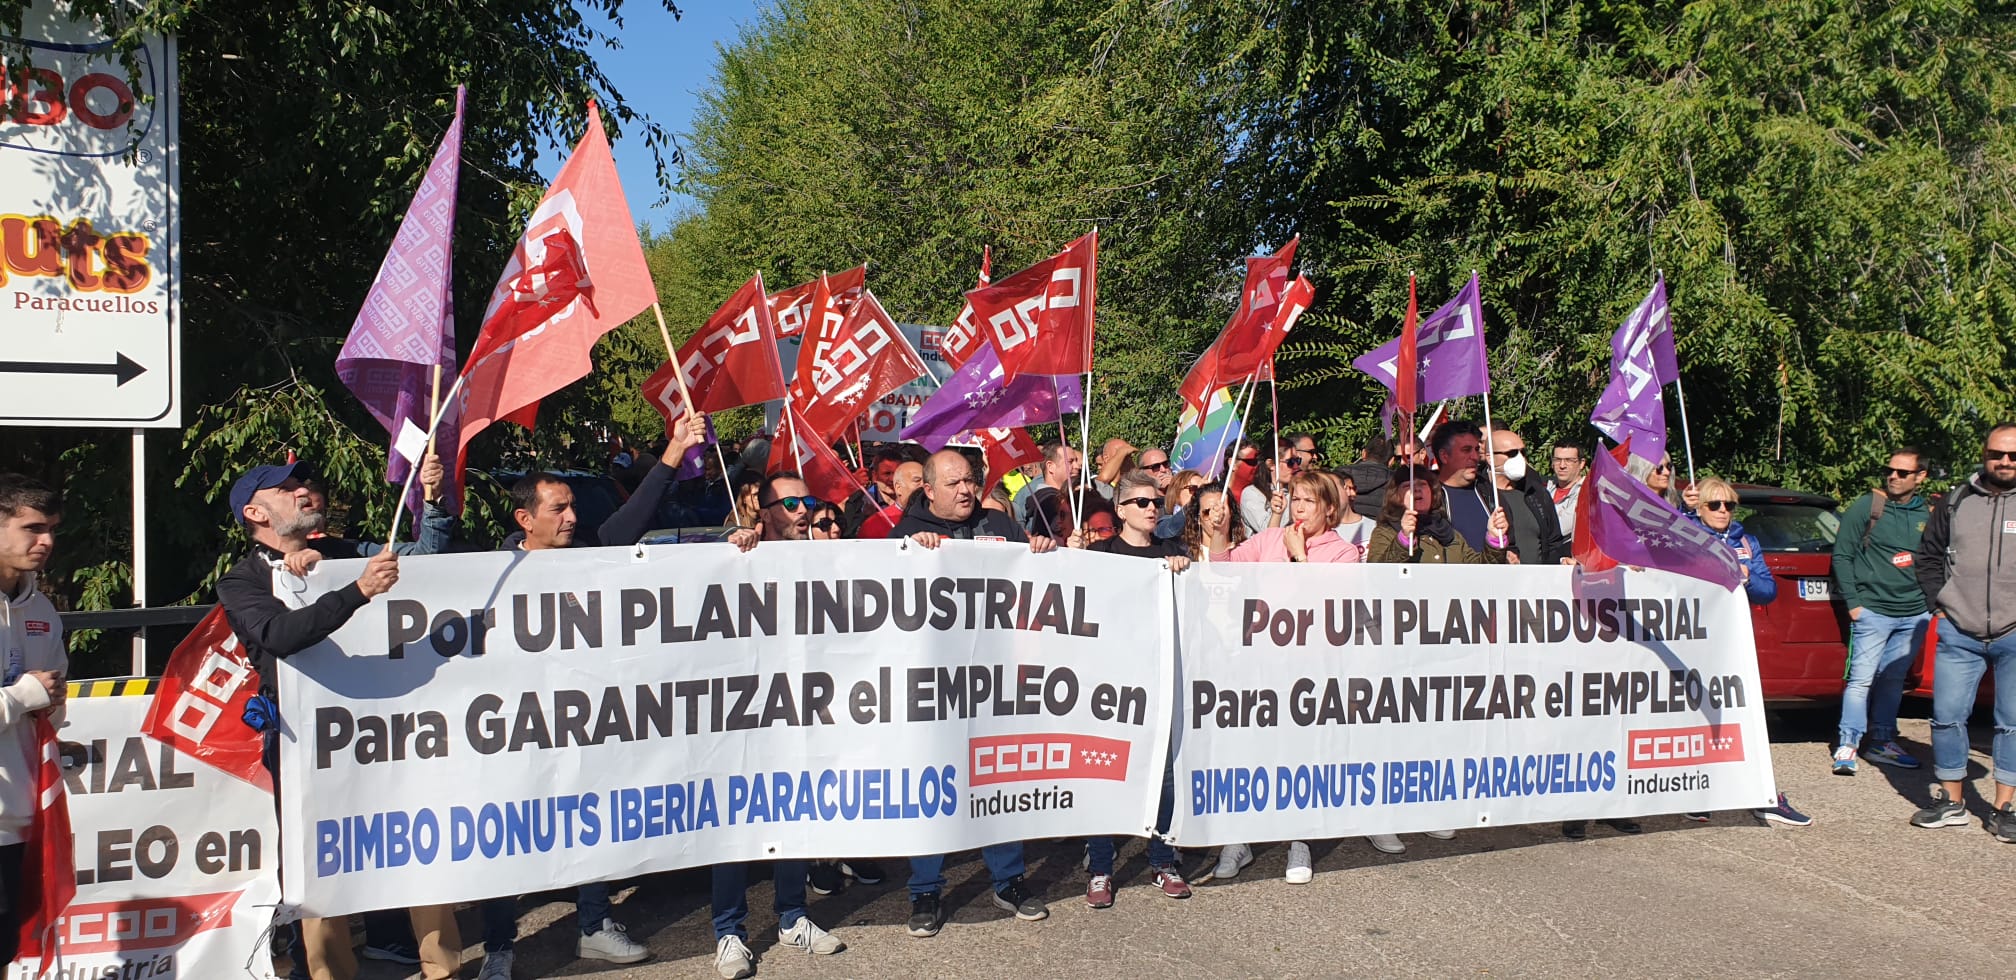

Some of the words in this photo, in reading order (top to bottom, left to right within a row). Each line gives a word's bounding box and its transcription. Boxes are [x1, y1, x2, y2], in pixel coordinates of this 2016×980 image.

[0, 63, 134, 129] BO
[0, 215, 150, 293] uts
[14, 291, 158, 314] Paracuellos
[388, 599, 495, 659] Por
[513, 590, 602, 653] UN
[621, 582, 777, 647] PLAN
[795, 577, 1099, 638] INDUSTRIAL
[1242, 598, 1314, 647] Por
[1324, 598, 1382, 647] UN
[1393, 598, 1498, 646] PLAN
[1508, 598, 1707, 644] INDUSTRIAL
[315, 706, 449, 769] Para
[465, 671, 835, 755] GARANTIZAR
[849, 666, 892, 724] el
[906, 664, 1079, 723] EMPLEO
[1090, 681, 1146, 727] en
[1192, 680, 1278, 729] Para
[1289, 674, 1536, 727] GARANTIZAR
[1545, 671, 1573, 718] el
[1582, 667, 1701, 717] EMPLEO
[1708, 674, 1746, 709] en
[974, 743, 1072, 774] CCOO
[1633, 733, 1705, 761] CCOO
[970, 786, 1074, 819] industria
[1191, 765, 1269, 816] BIMBO
[1275, 761, 1376, 811] DONUTS
[1382, 758, 1457, 805] IBERIA
[1462, 750, 1616, 800] PARACUELLOS
[1627, 770, 1710, 795] industria
[316, 806, 440, 878] BIMBO
[450, 791, 600, 862] DONUTS
[610, 777, 719, 843] IBERIA
[728, 765, 957, 826] PARACUELLOS
[196, 827, 262, 876] en
[57, 908, 177, 946] COO
